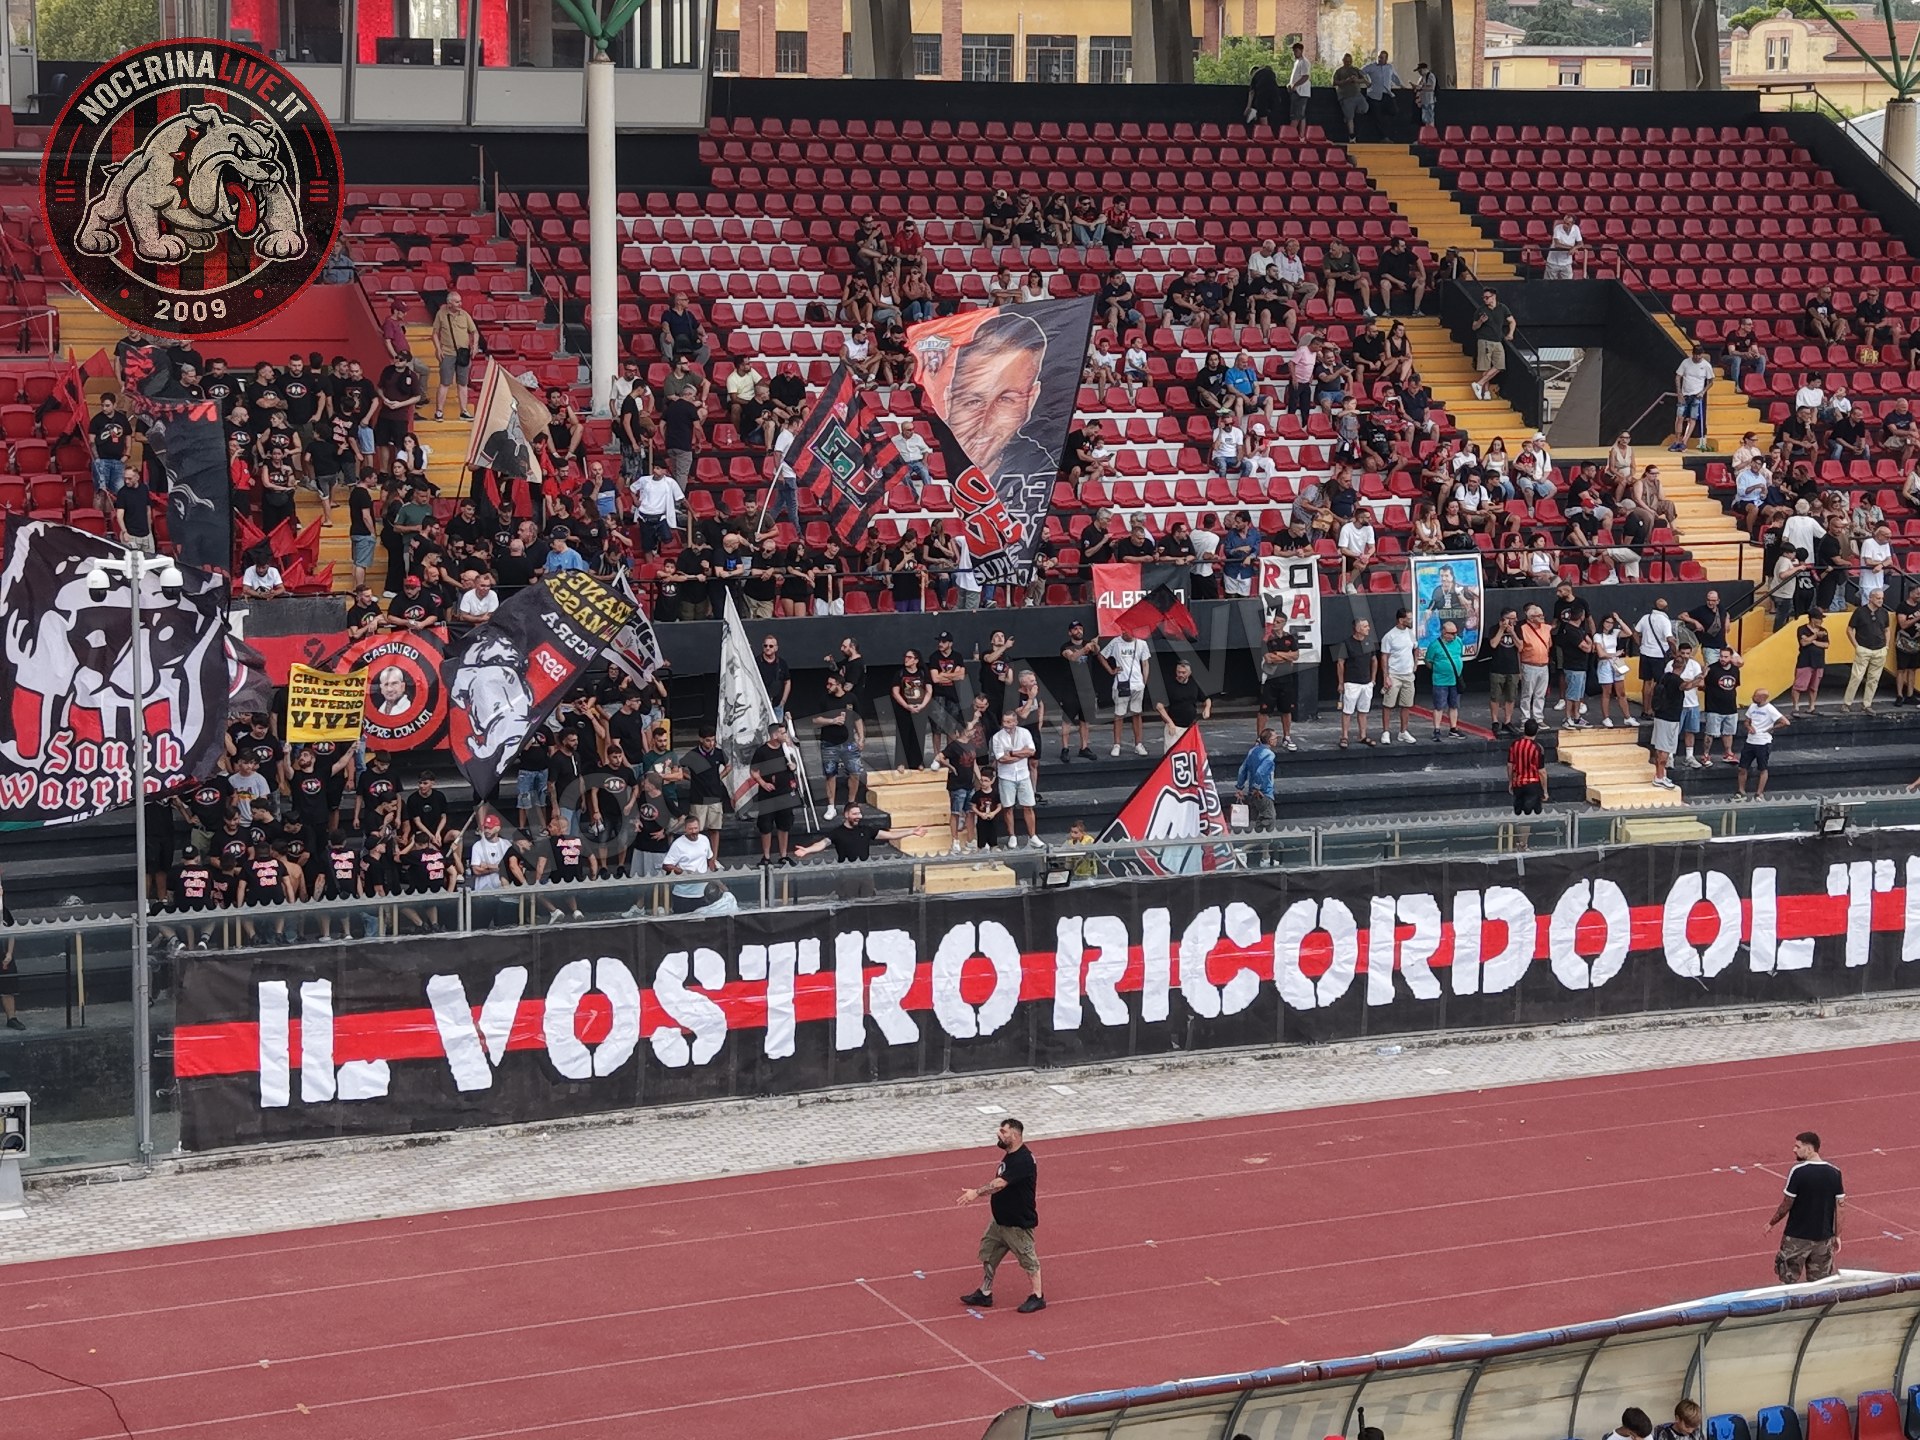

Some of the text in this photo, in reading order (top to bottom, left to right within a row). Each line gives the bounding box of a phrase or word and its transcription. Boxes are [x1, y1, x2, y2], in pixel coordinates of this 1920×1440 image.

[362, 642, 419, 664] CASIMIRO
[292, 673, 320, 684] CHI
[344, 676, 366, 687] UN
[292, 686, 365, 697] IDEALE CREDE
[291, 697, 364, 709] IN ETERNO
[291, 711, 362, 729] VIVE
[43, 730, 184, 775] South
[258, 979, 391, 1108] IL
[426, 920, 1022, 1092] VOSTRO
[1052, 877, 1631, 1031] RICORDO
